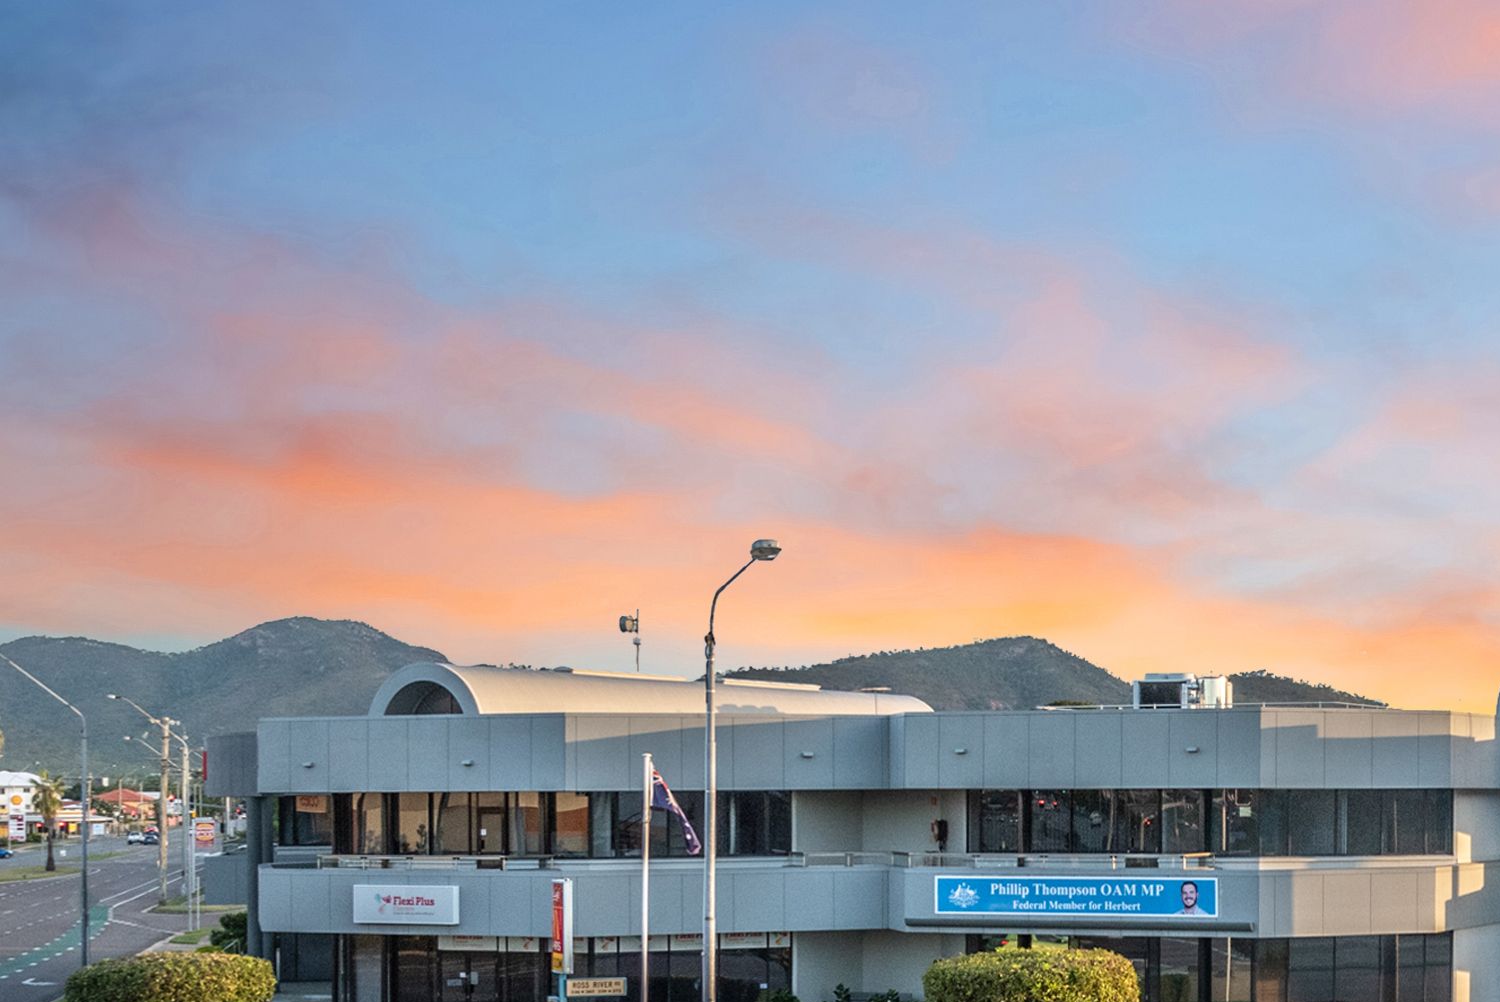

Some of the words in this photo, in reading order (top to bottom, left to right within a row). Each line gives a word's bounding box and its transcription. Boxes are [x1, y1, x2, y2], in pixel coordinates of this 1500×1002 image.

[990, 882, 1029, 899] Phillip
[1032, 883, 1097, 899] Thompson
[1100, 883, 1136, 896] OAM
[1141, 883, 1164, 896] MP
[393, 896, 415, 906] Flexi
[415, 896, 435, 906] Plus
[1012, 900, 1047, 910] Federal
[1049, 900, 1087, 910] Member
[1088, 900, 1102, 910] for
[1104, 900, 1141, 911] Herbert
[572, 981, 590, 989] ROSS
[592, 980, 613, 988] RIVER
